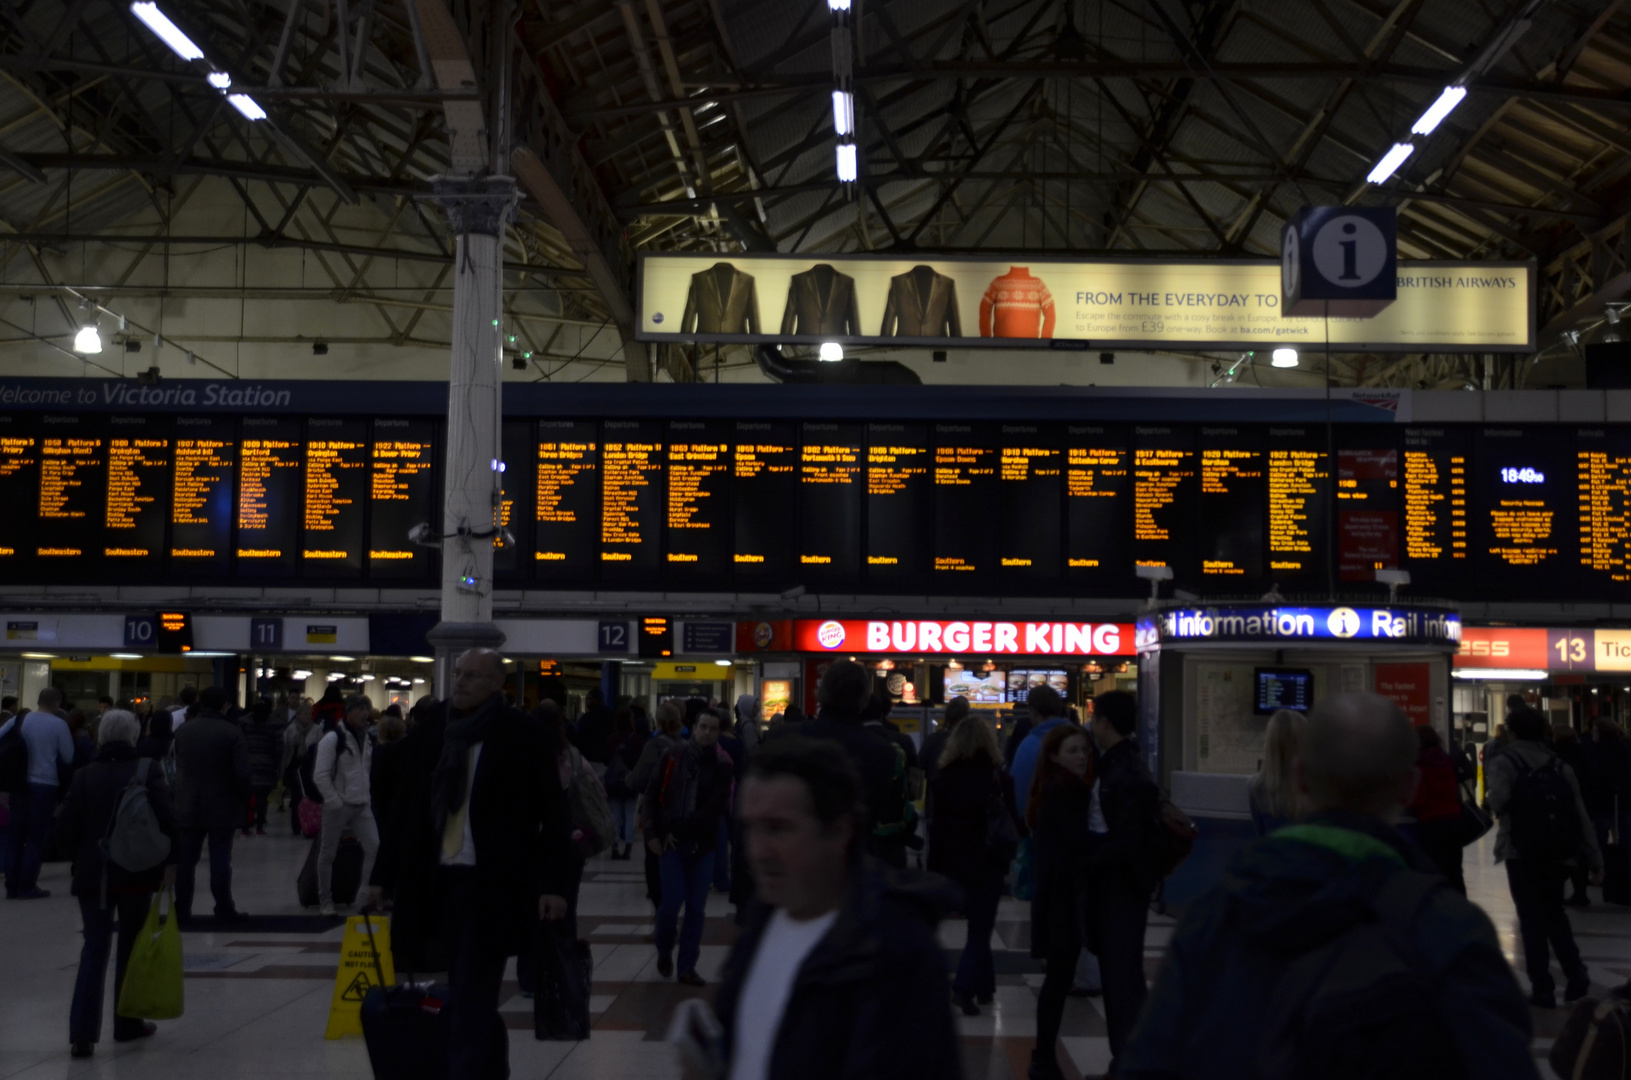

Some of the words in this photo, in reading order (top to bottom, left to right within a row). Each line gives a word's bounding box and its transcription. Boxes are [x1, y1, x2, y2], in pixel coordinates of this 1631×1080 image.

[1397, 277, 1452, 288] BRITISH
[1456, 277, 1516, 288] AIRWAYS
[1076, 291, 1122, 306] FROM
[1128, 292, 1160, 306] THE
[1165, 293, 1249, 307] EVERYDAY
[1255, 294, 1278, 307] TO
[1076, 312, 1105, 321] Escape
[1107, 312, 1121, 320] the
[1123, 313, 1162, 321] commute
[1165, 313, 1182, 321] with
[1192, 315, 1210, 323] cosy
[1212, 313, 1236, 322] break
[1238, 314, 1245, 322] in
[1087, 324, 1117, 333] Europe
[1119, 323, 1138, 332] from
[1141, 321, 1164, 333] £39
[1206, 325, 1228, 334] Book
[1240, 326, 1308, 336] ba.com/gatwick
[78, 388, 96, 404] to
[103, 384, 196, 406] Victoria
[204, 384, 291, 407] Station
[39, 548, 81, 556] Southeastern
[128, 621, 152, 641] 10
[257, 623, 275, 643] 11
[1179, 609, 1314, 637] information
[1372, 611, 1417, 638] Rail
[602, 625, 625, 645] 12
[866, 620, 1018, 653] BURGER
[1025, 622, 1121, 654] KING
[1555, 638, 1587, 662] 13
